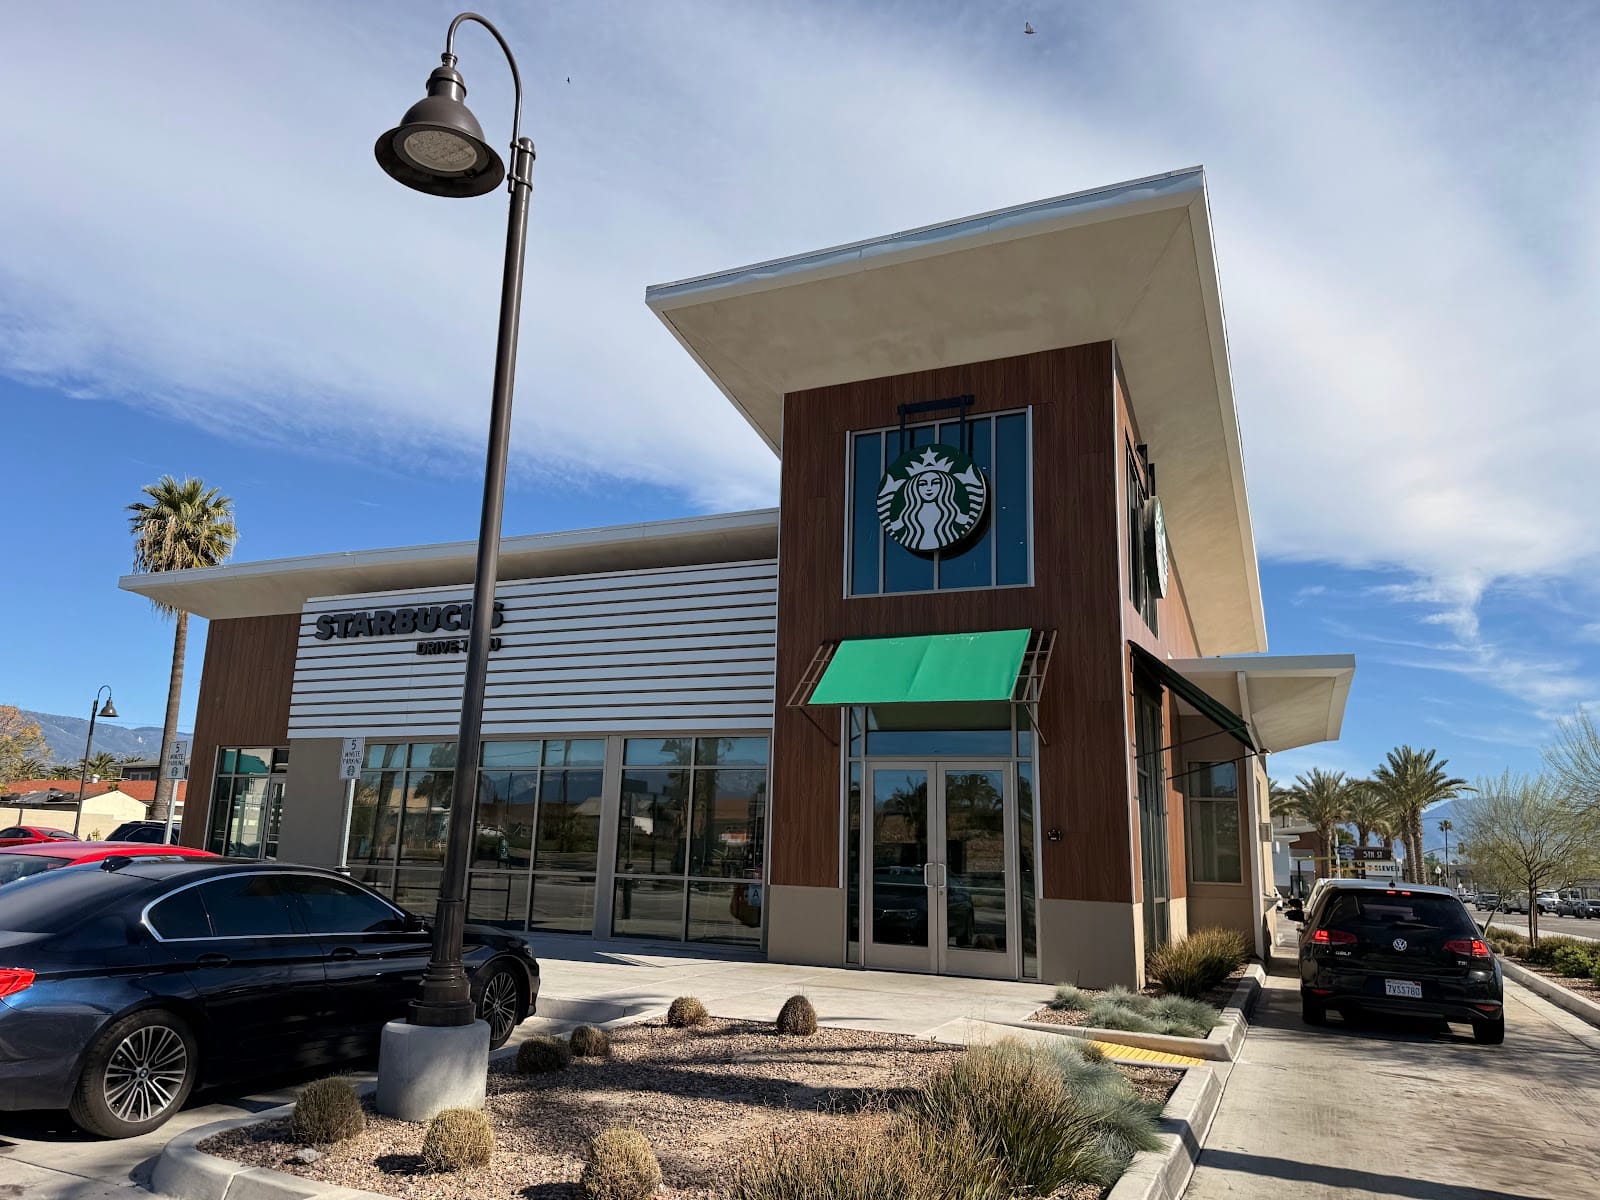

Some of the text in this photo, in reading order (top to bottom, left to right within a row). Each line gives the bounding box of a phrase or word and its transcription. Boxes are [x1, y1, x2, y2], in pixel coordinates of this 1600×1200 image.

[416, 638, 501, 655] DRIVE-TU
[176, 743, 180, 753] 5
[351, 739, 357, 750] 5
[752, 889, 760, 898] A
